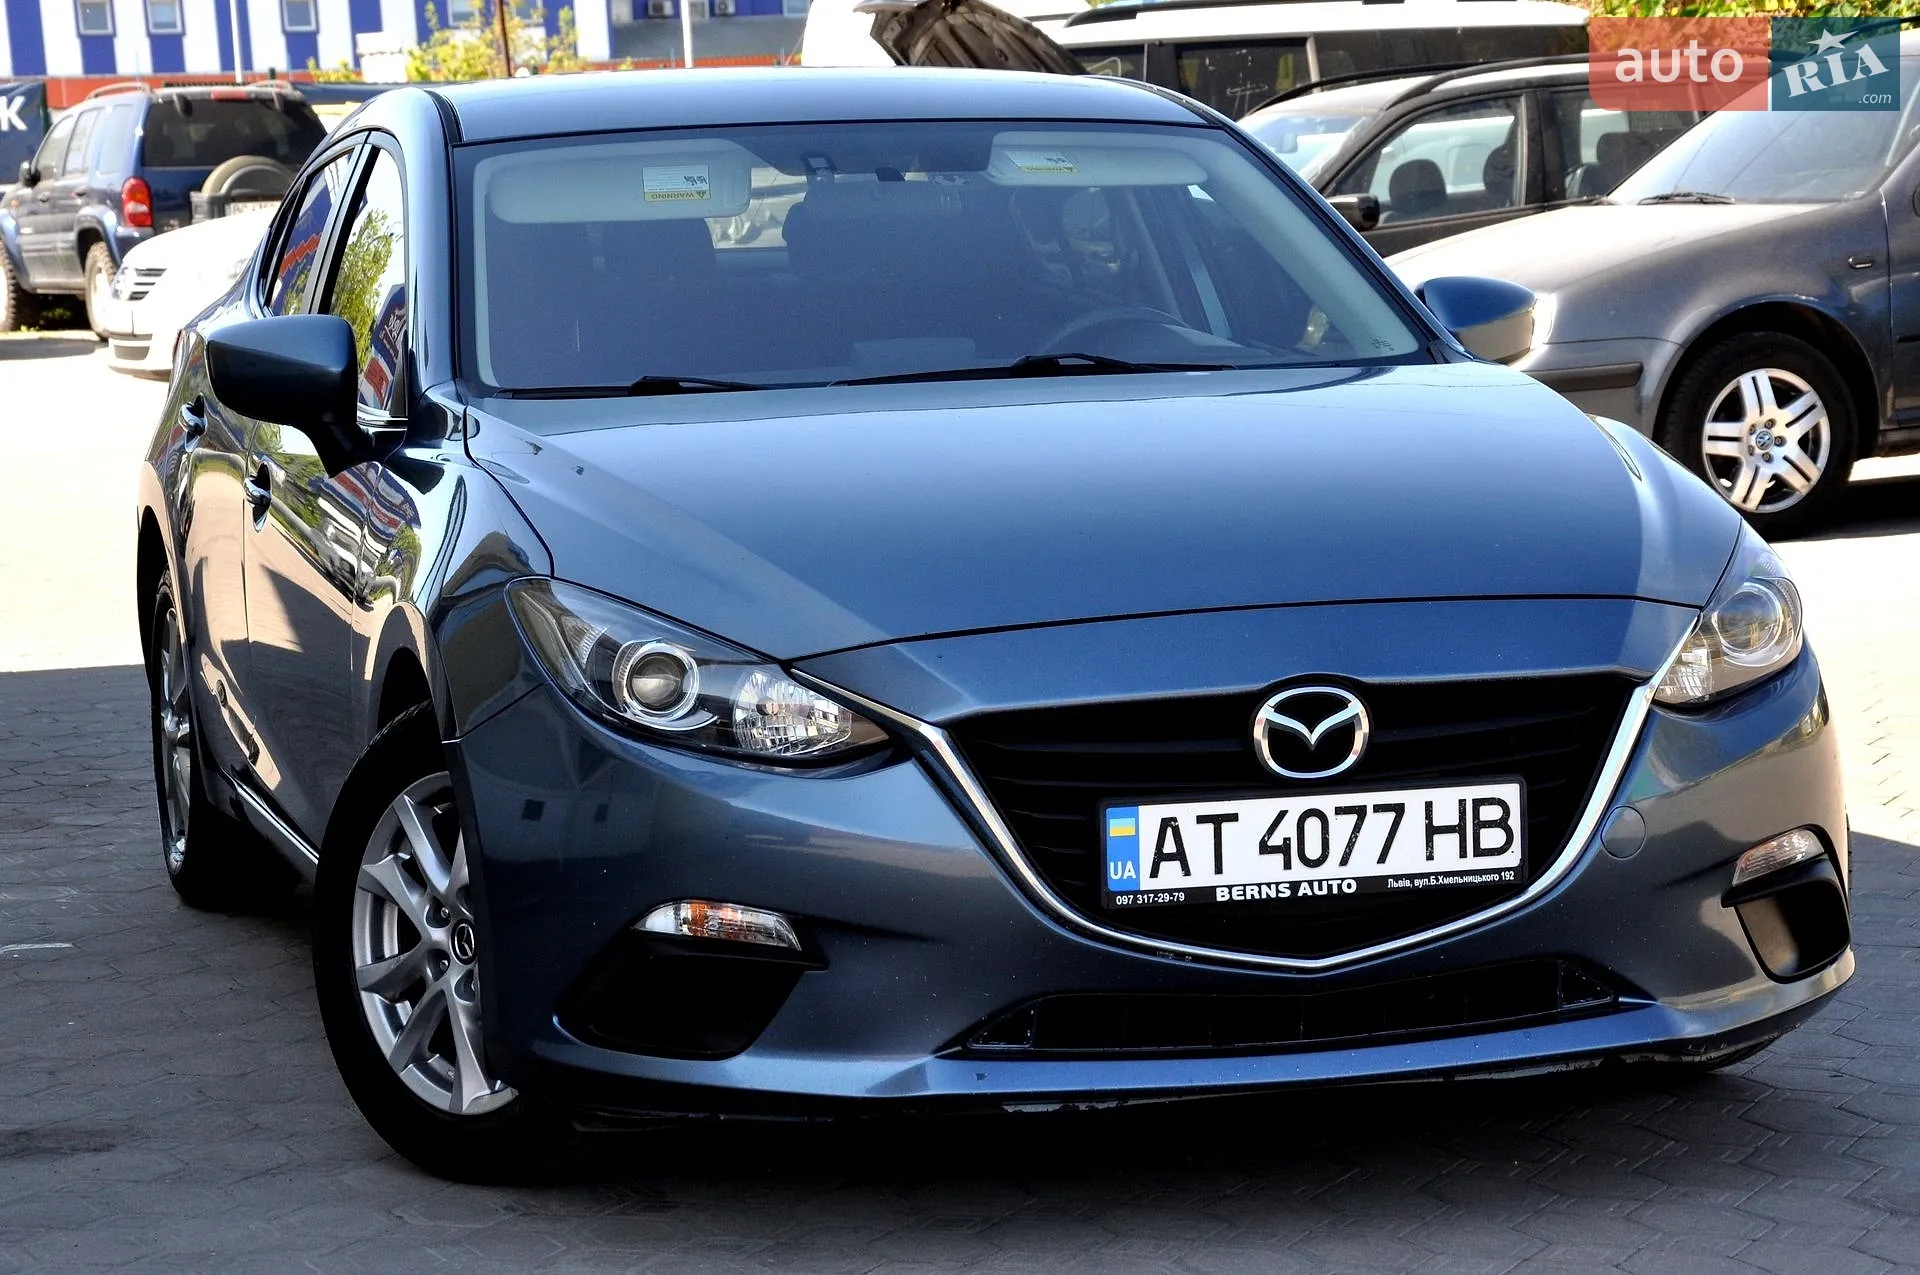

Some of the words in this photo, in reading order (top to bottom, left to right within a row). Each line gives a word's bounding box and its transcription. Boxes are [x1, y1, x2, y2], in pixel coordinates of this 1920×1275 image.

[1149, 813, 1239, 879] AT
[1258, 803, 1405, 871] 4077
[1424, 797, 1515, 862] HB
[1109, 860, 1137, 880] UA
[1501, 870, 1514, 880] 192
[1116, 895, 1134, 906] 097
[1136, 892, 1185, 905] 317-29-79
[1215, 883, 1292, 902] BERNS
[1297, 879, 1357, 897] AUTO
